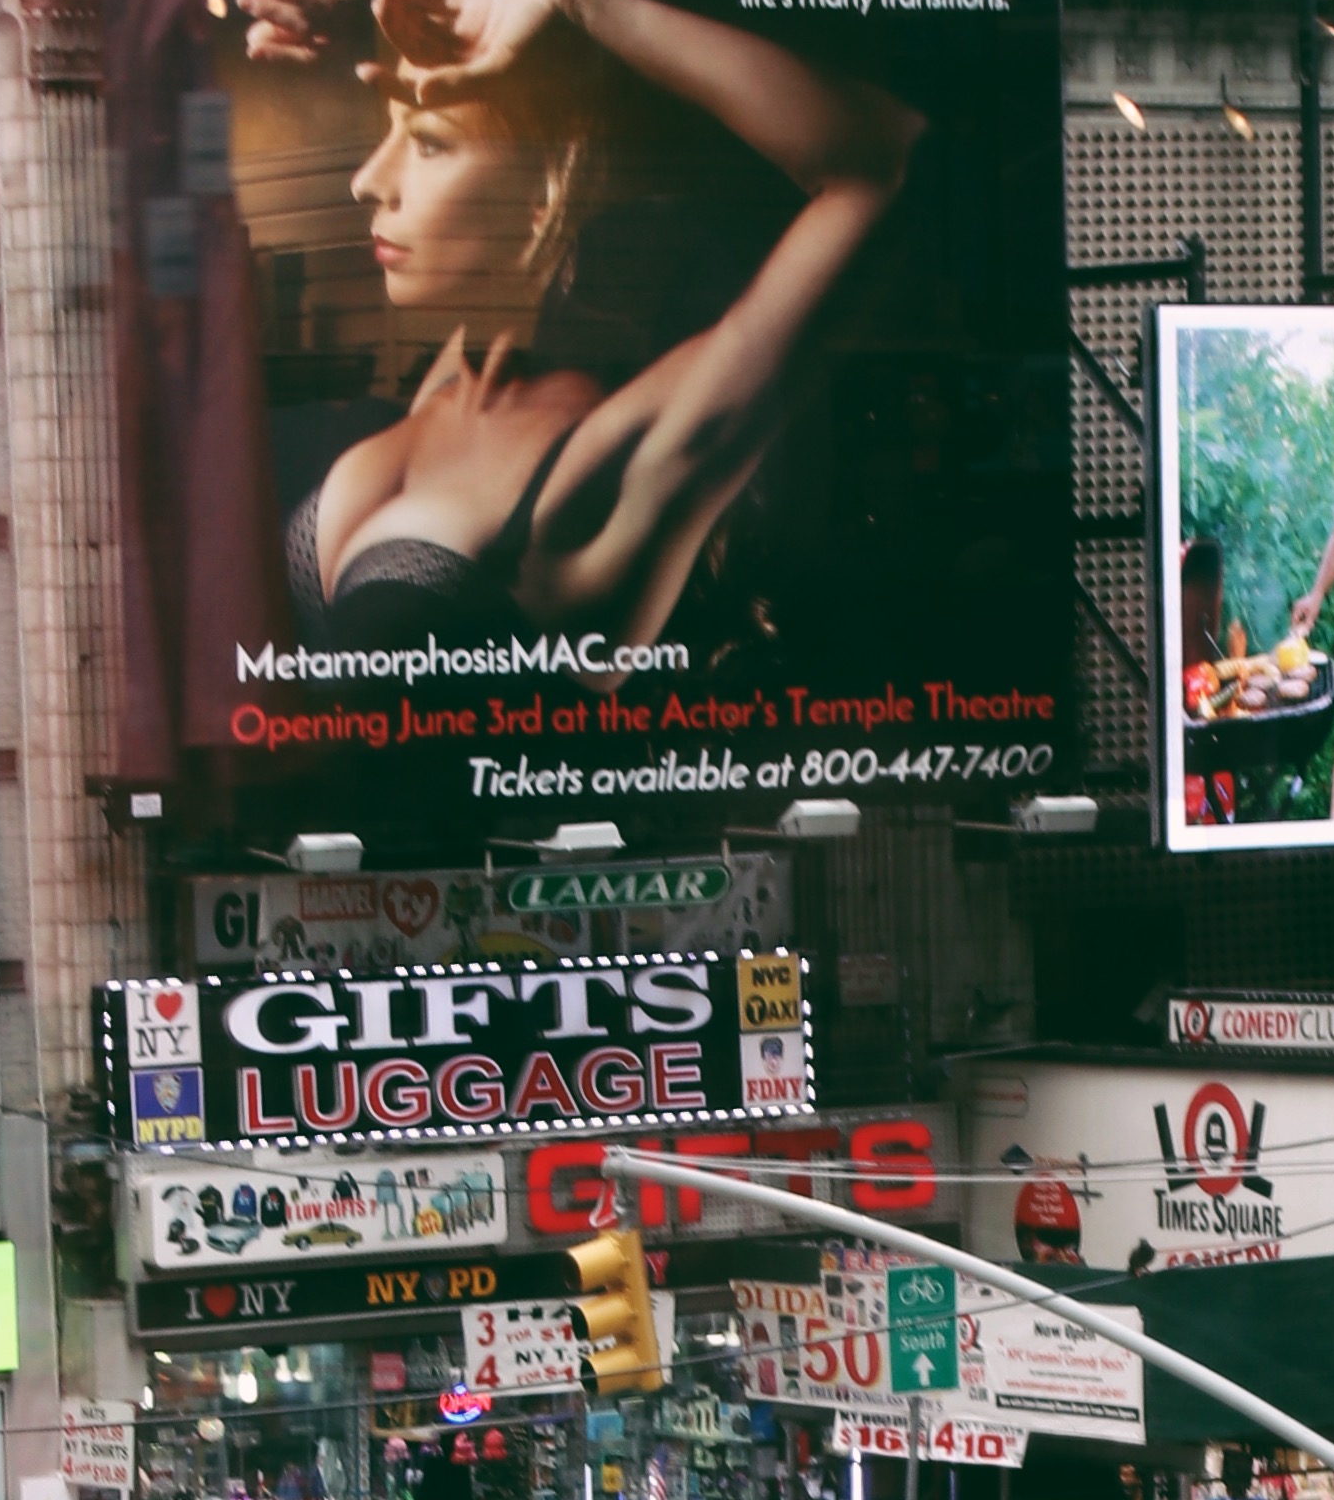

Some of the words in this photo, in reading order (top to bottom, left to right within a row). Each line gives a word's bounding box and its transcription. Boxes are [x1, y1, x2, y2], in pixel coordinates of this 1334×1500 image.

[236, 632, 689, 684] MetamorphosisMAC.com
[231, 704, 389, 751] Opening
[396, 698, 475, 744] June
[486, 692, 543, 736] 3rd
[552, 700, 587, 734] at
[597, 690, 651, 732] the
[659, 691, 779, 731] Actor's
[784, 685, 914, 732] Temple
[923, 682, 1054, 722] Theatre
[468, 756, 583, 799] Tickets
[592, 748, 747, 794] available
[756, 755, 794, 788] at
[800, 744, 1054, 789] 800-447-7400
[526, 871, 710, 905] LAMAR
[751, 965, 792, 987] NYC
[138, 993, 153, 1023] I
[226, 964, 714, 1055] GIFTS
[135, 1026, 190, 1059] NY
[238, 1041, 707, 1136] LUGGAGE
[747, 1077, 803, 1102] FDNY
[138, 1115, 203, 1145] NYPD
[295, 1201, 322, 1222] LUV
[325, 1199, 366, 1220] GIFTS
[1153, 1189, 1210, 1234] TIMES
[1213, 1193, 1285, 1240] SQUARE
[184, 1286, 204, 1320] I
[238, 1280, 297, 1317] NY
[367, 1271, 421, 1306] NY
[447, 1264, 498, 1299] PD
[476, 1311, 496, 1347] 3
[899, 1331, 947, 1352] South
[1033, 1319, 1061, 1338] Now
[803, 1318, 882, 1388] 50
[474, 1354, 502, 1389] 4
[935, 1421, 955, 1457] 4
